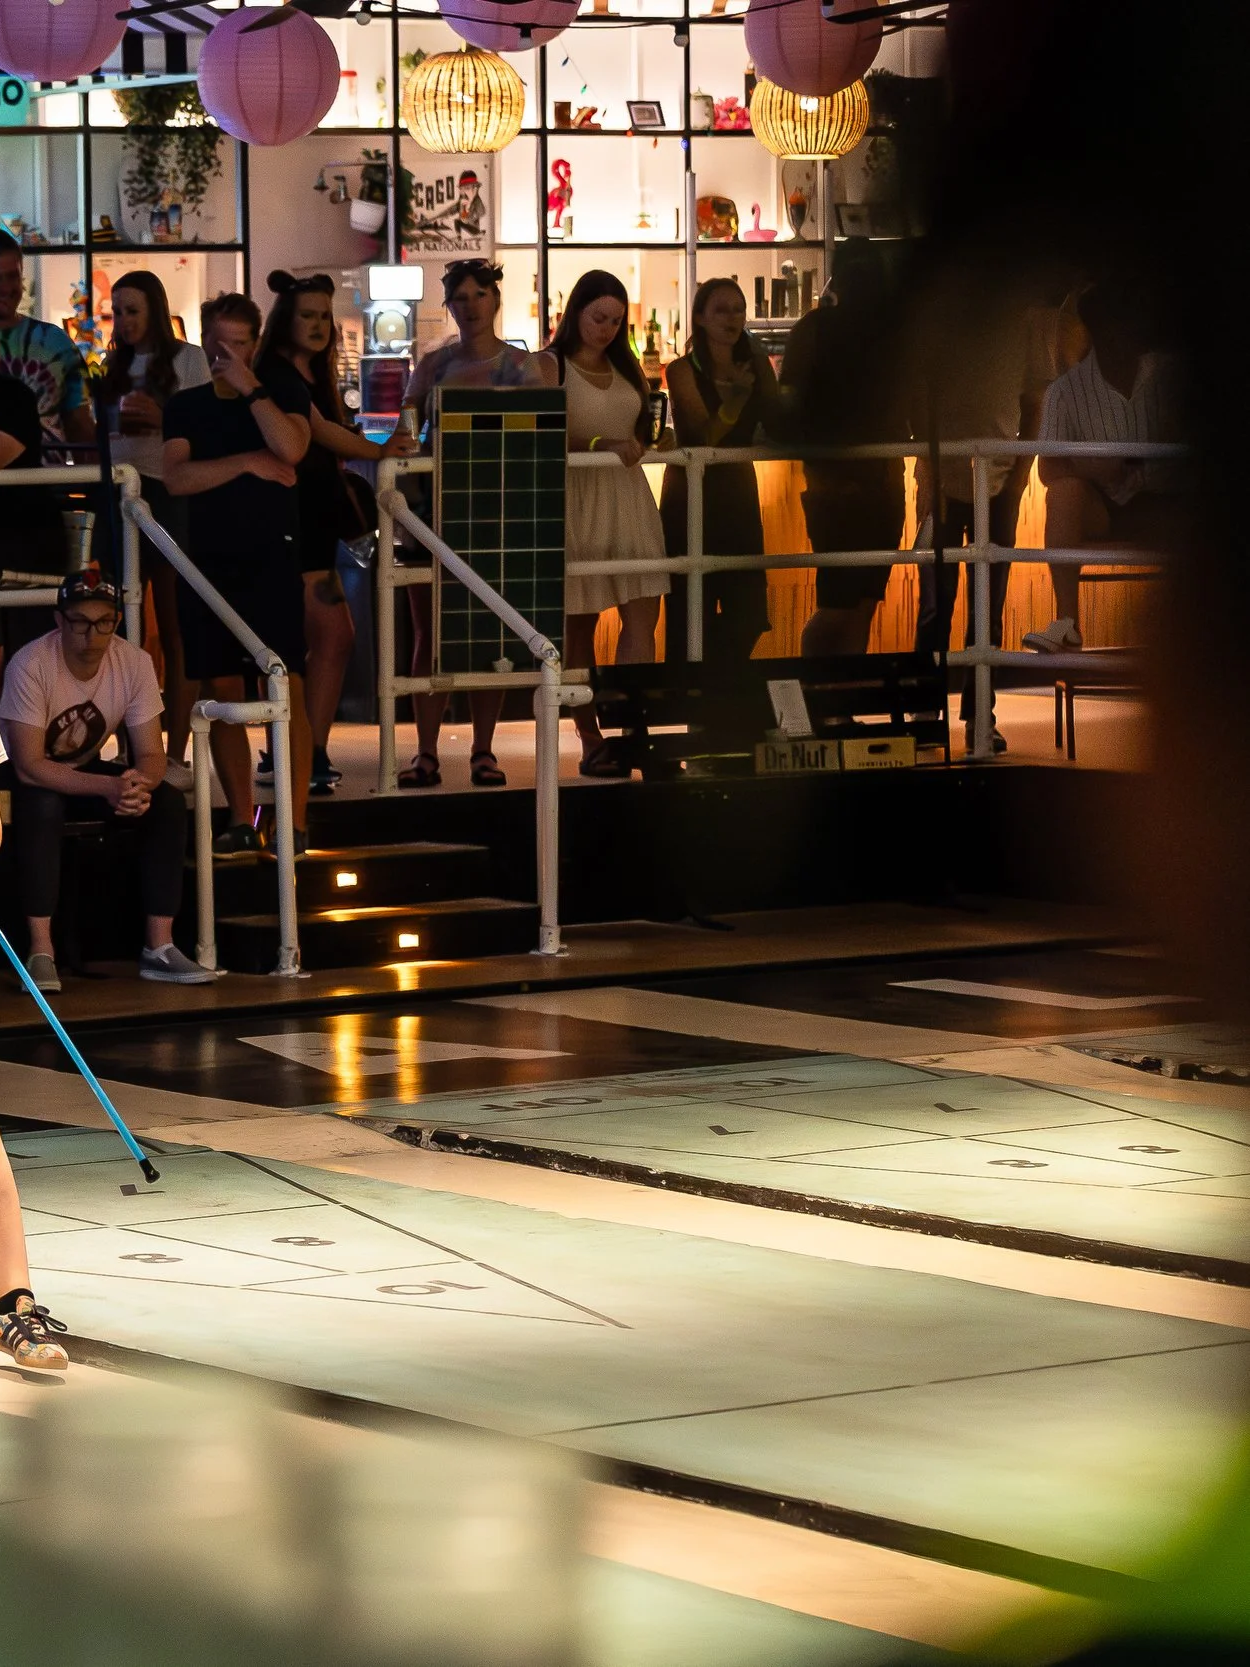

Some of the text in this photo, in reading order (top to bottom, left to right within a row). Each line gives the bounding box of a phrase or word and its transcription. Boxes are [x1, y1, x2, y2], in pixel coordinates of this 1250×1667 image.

[414, 176, 455, 210] CAGO
[424, 238, 481, 252] NATIONALS
[791, 743, 827, 769] Nut
[1117, 1144, 1182, 1155] 8
[986, 1158, 1050, 1169] 8
[270, 1236, 336, 1247] 8
[118, 1252, 183, 1264] 8
[375, 1279, 489, 1296] 10
